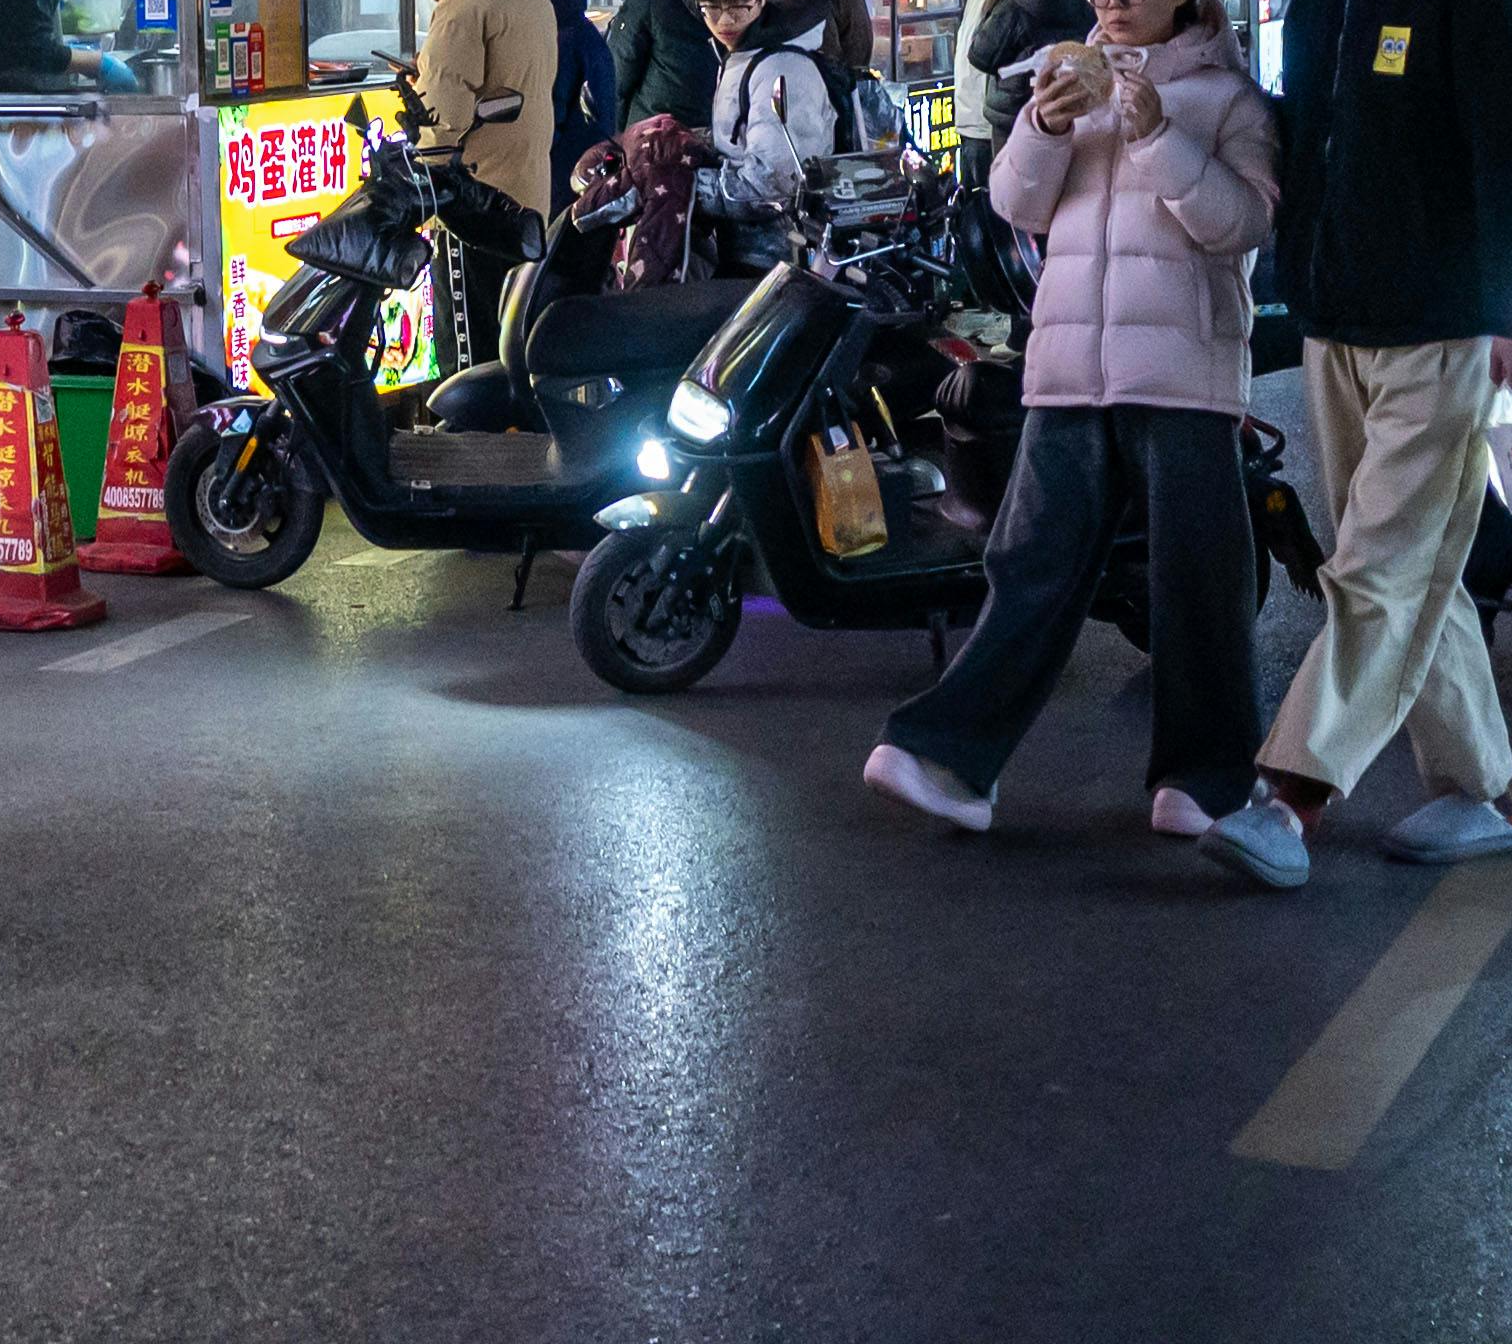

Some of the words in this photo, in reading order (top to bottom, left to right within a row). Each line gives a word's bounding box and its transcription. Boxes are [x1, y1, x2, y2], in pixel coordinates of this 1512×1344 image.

[227, 121, 347, 204] 鸡蛋灌饼
[231, 257, 248, 388] 鲜香美味
[103, 486, 165, 510] 4008557789
